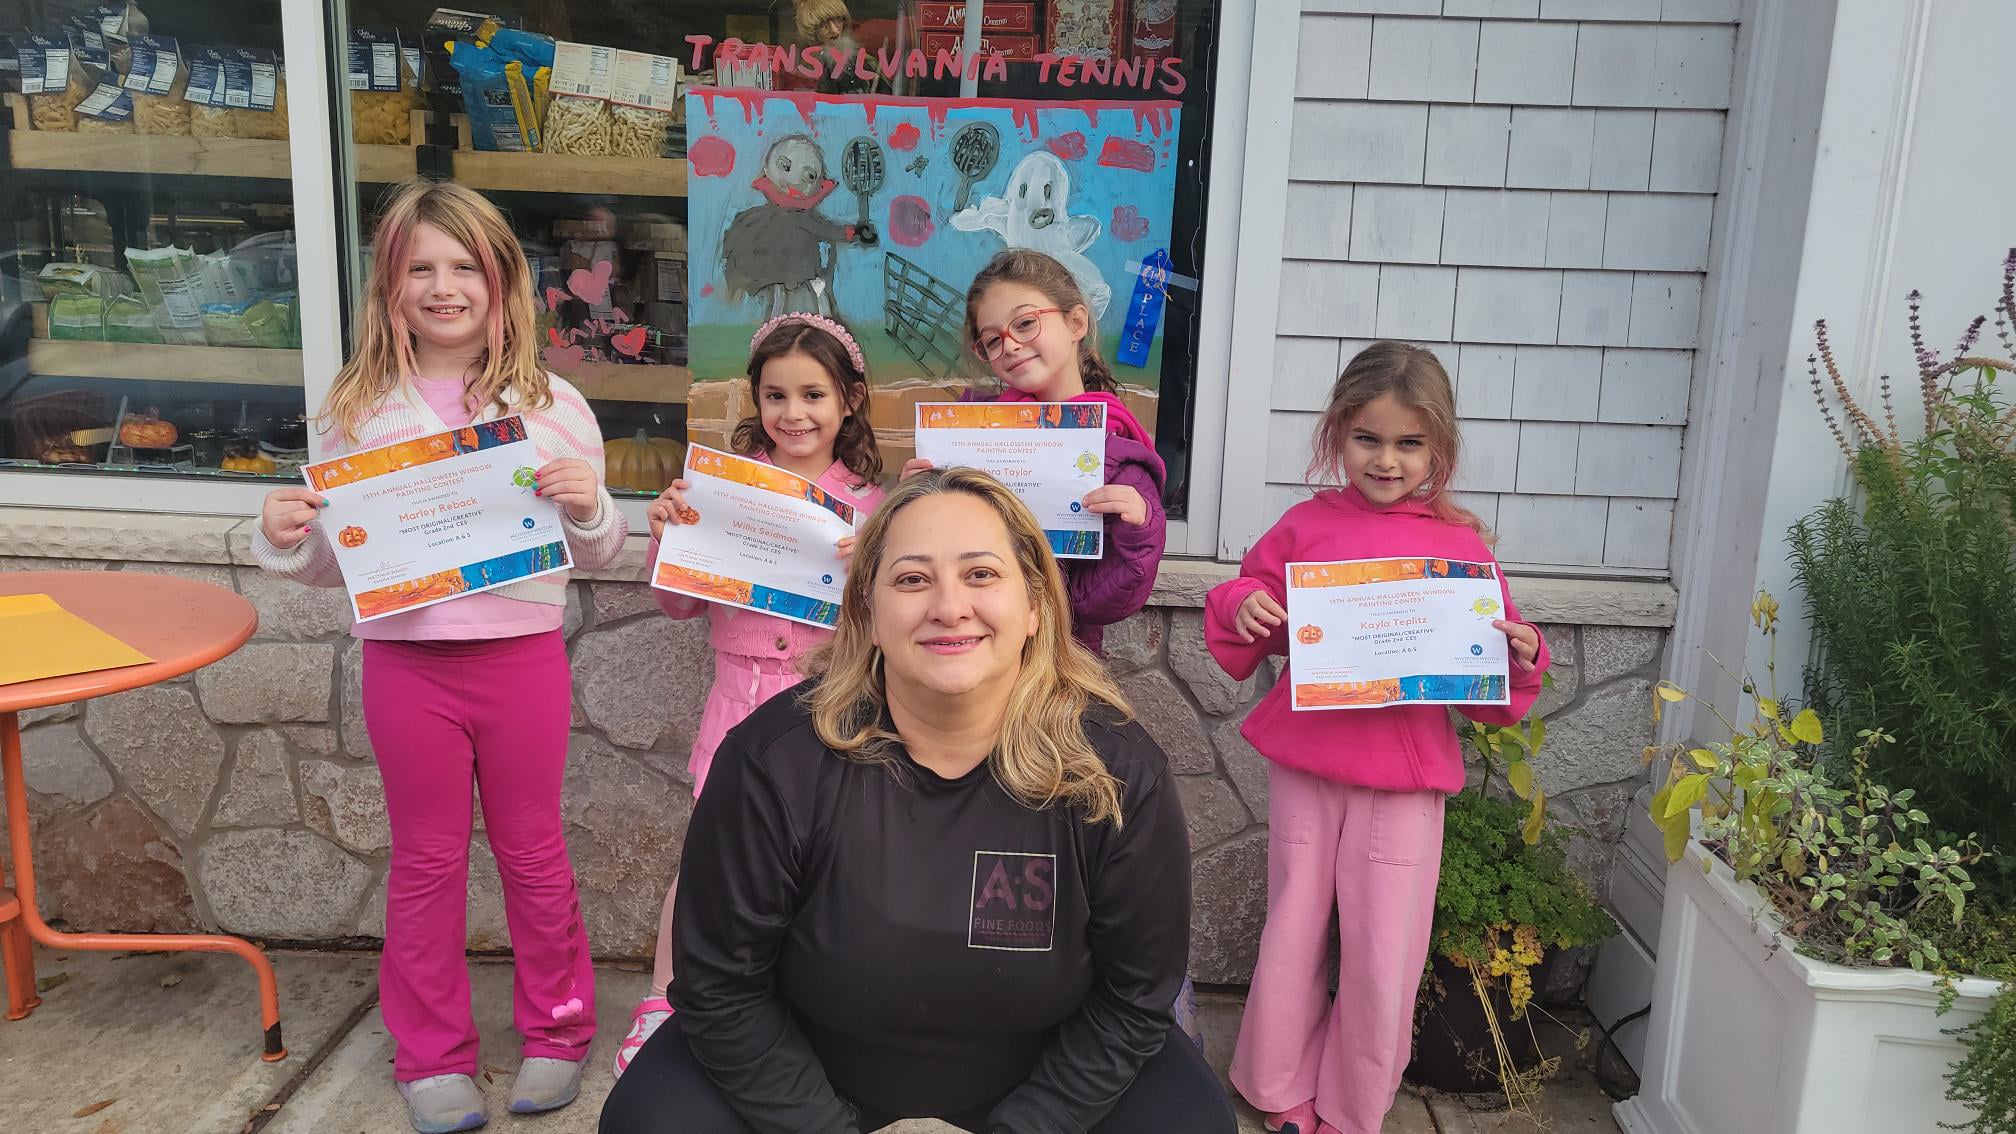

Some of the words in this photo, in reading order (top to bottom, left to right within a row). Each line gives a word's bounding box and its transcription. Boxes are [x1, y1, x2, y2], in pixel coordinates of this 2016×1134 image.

[684, 34, 1007, 82] TRANSYLVANIA
[1032, 53, 1187, 95] TENNIS
[1129, 292, 1153, 353] PLACE
[381, 482, 412, 495] ANNUAL
[414, 471, 458, 486] HALLOWEEN
[459, 463, 493, 476] WINDOW
[1004, 467, 1033, 478] Taylor
[396, 485, 432, 498] PAINTING
[433, 477, 465, 489] CONTEST
[399, 507, 436, 523] Marley
[439, 496, 478, 513] Reback
[729, 495, 756, 505] ANNUAL
[759, 502, 798, 517] HALLOWEEN
[799, 512, 827, 523] WINDOW
[739, 503, 770, 516] PAINTING
[771, 512, 800, 523] CONTEST
[424, 527, 442, 536] Grade
[732, 519, 756, 533] Willa
[758, 527, 798, 544] Seidman
[1347, 595, 1375, 603] ANNUAL
[1377, 591, 1421, 600] HALLOWEEN
[1358, 600, 1393, 608] PAINTING
[1394, 596, 1425, 605] CONTEST
[1360, 620, 1390, 630] Kayla
[1392, 616, 1427, 627] Teplitz
[974, 918, 1004, 930] FINE
